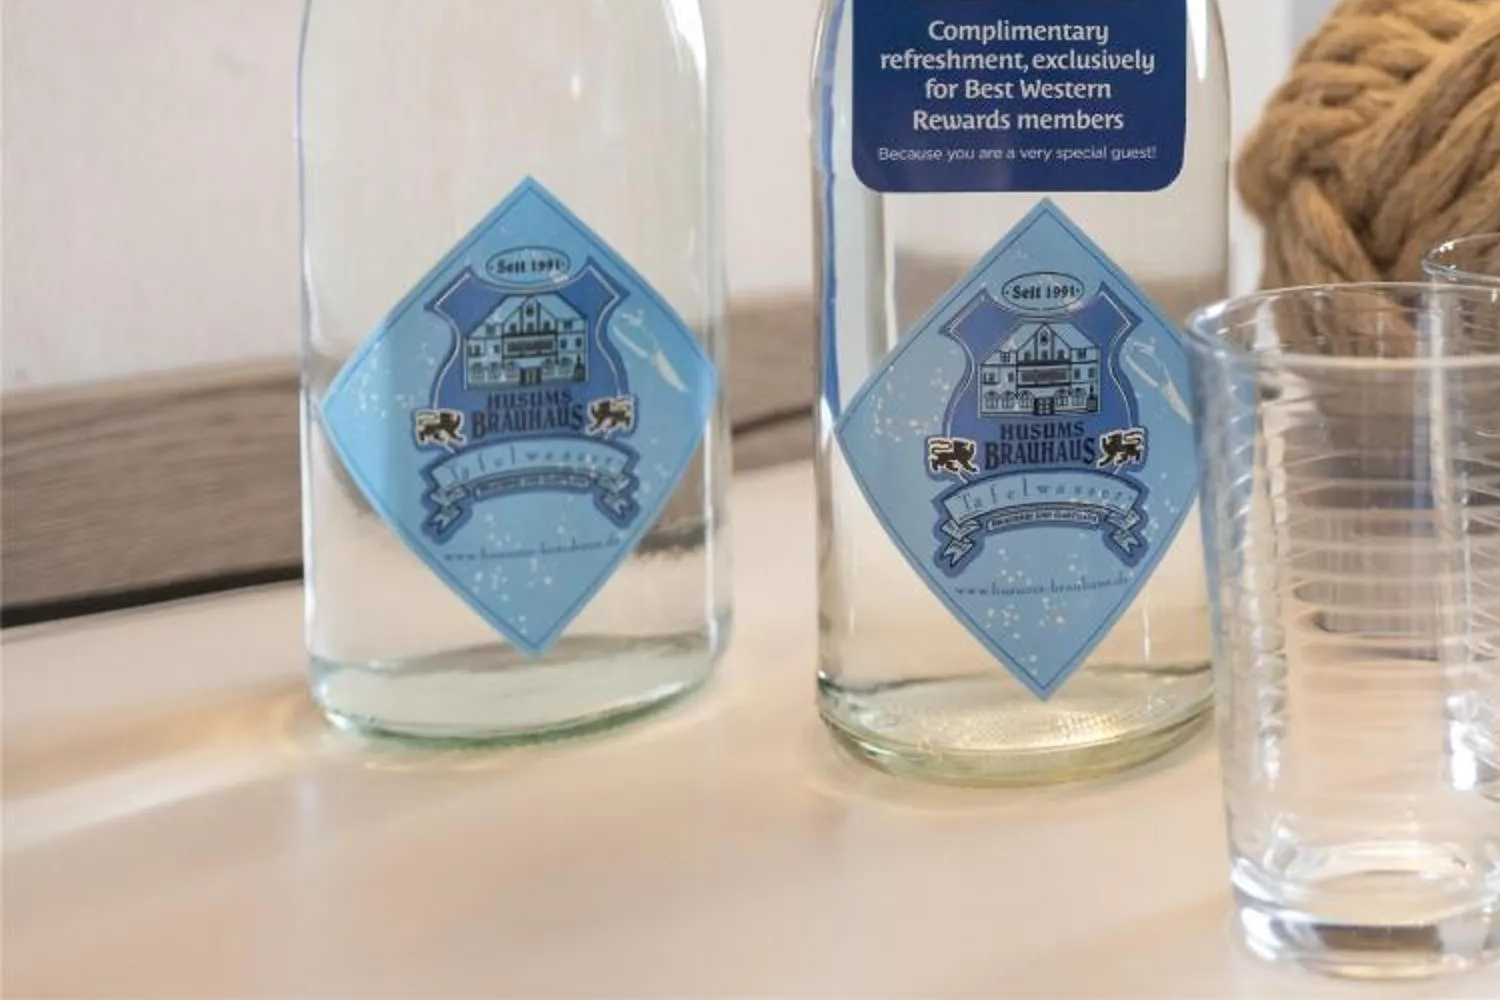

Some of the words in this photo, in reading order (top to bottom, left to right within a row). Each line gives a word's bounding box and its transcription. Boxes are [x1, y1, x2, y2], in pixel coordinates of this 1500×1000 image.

[928, 19, 1110, 46] Complimentary
[880, 48, 1029, 73] refreshment,
[1032, 49, 1156, 75] exclusively
[925, 78, 958, 99] for
[965, 79, 1014, 100] Best
[1020, 79, 1111, 100] Western
[913, 109, 1011, 131] Rewards
[1017, 109, 1124, 131] members
[878, 146, 943, 162] Because
[947, 147, 974, 165] you
[978, 148, 1002, 161] are
[1005, 148, 1016, 161] a
[1020, 148, 1051, 164] very
[1055, 145, 1107, 163] special
[1112, 146, 1157, 163] guest!
[1011, 284, 1042, 300] Seit
[1046, 284, 1076, 299] 1991
[471, 401, 586, 439] BRAUHAUS
[999, 420, 1086, 441] HUSUMS
[984, 437, 1097, 470] BRAUHAUS
